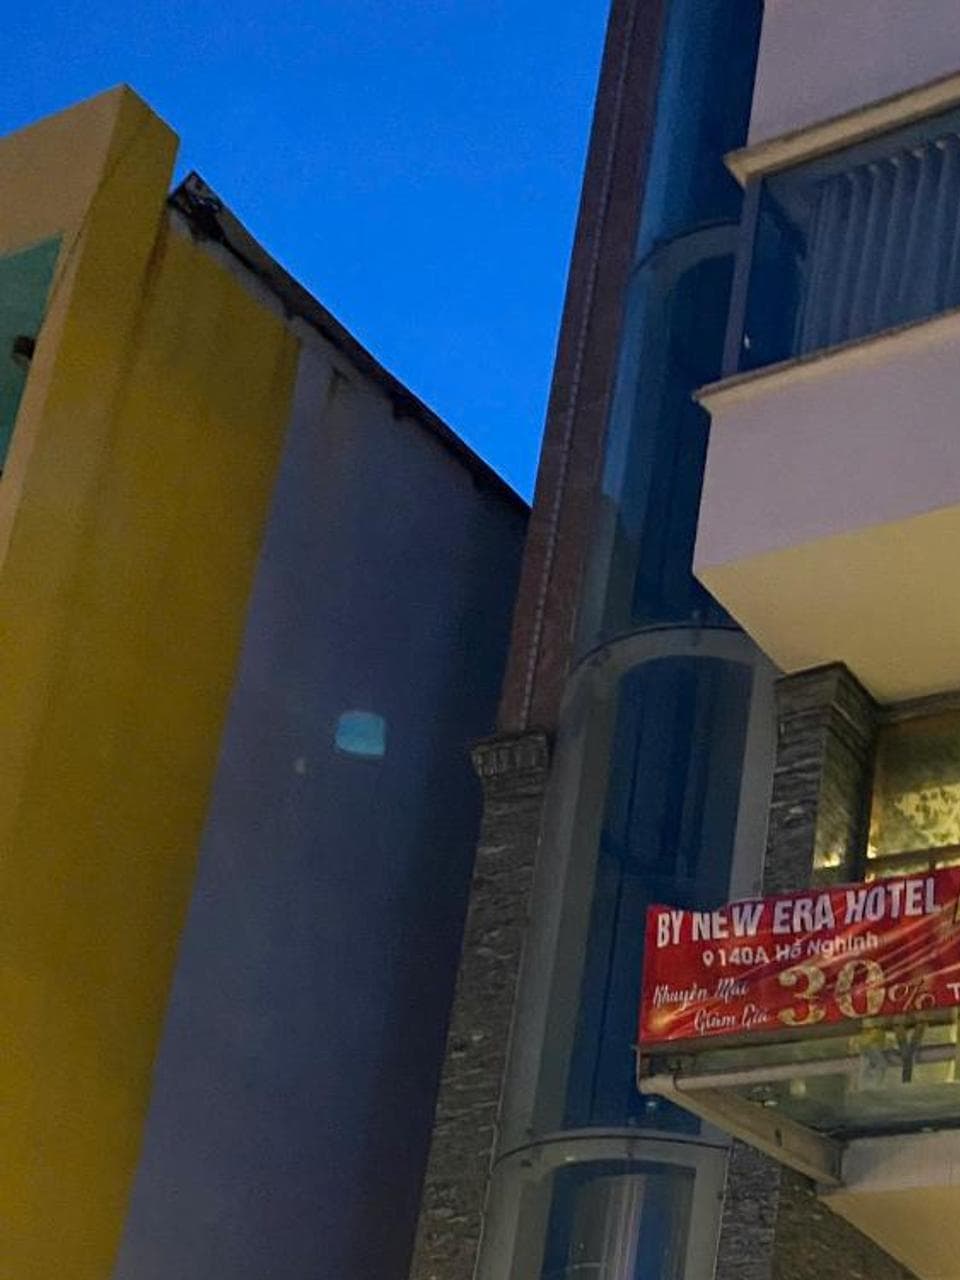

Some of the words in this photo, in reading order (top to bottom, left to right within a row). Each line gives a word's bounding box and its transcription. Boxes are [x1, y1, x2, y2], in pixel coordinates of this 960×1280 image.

[656, 910, 685, 948] BY
[691, 902, 764, 942] NEW
[773, 891, 834, 933] ERA
[844, 876, 943, 923] HOTEL
[718, 948, 769, 967] 140A
